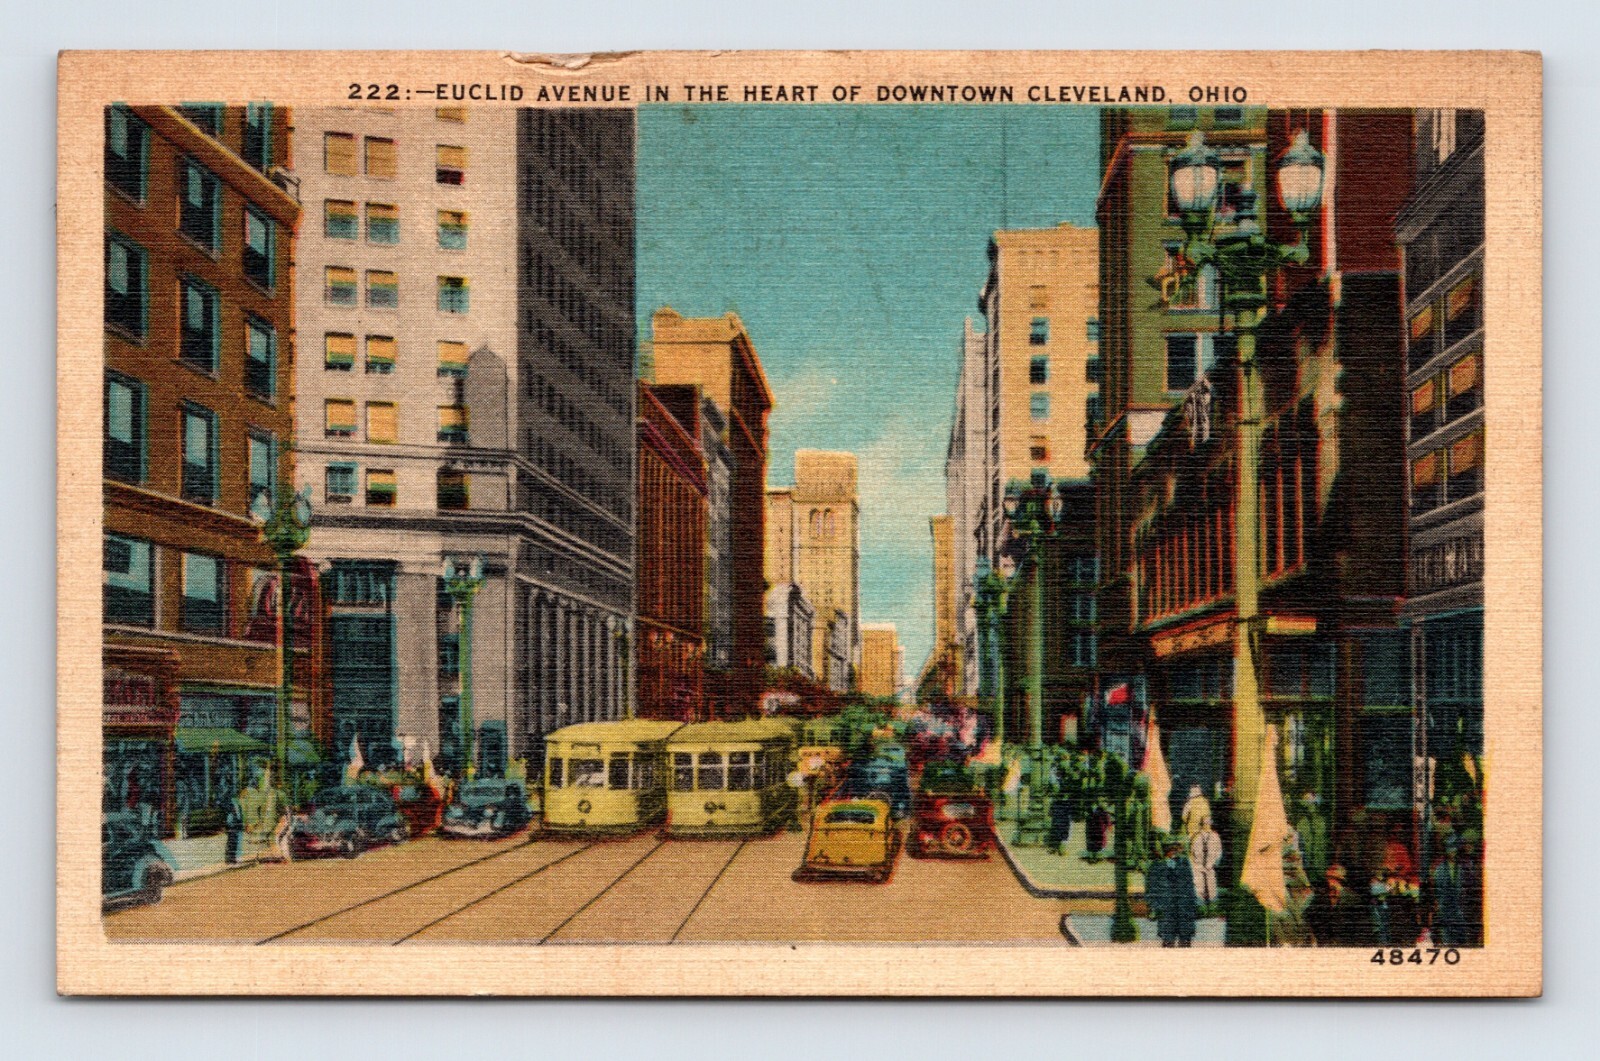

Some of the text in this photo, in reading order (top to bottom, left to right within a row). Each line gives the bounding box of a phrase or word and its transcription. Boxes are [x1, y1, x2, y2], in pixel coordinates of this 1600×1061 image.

[536, 84, 631, 102] AVENUE
[646, 85, 669, 102] IN
[683, 85, 729, 102] THE
[743, 85, 819, 102] HEART
[832, 85, 862, 102] OF
[877, 85, 1014, 102] DOWNTOWN
[1027, 85, 1173, 104] CLEVELAND,
[1188, 85, 1247, 103] OHIO
[1370, 948, 1461, 966] 48470
